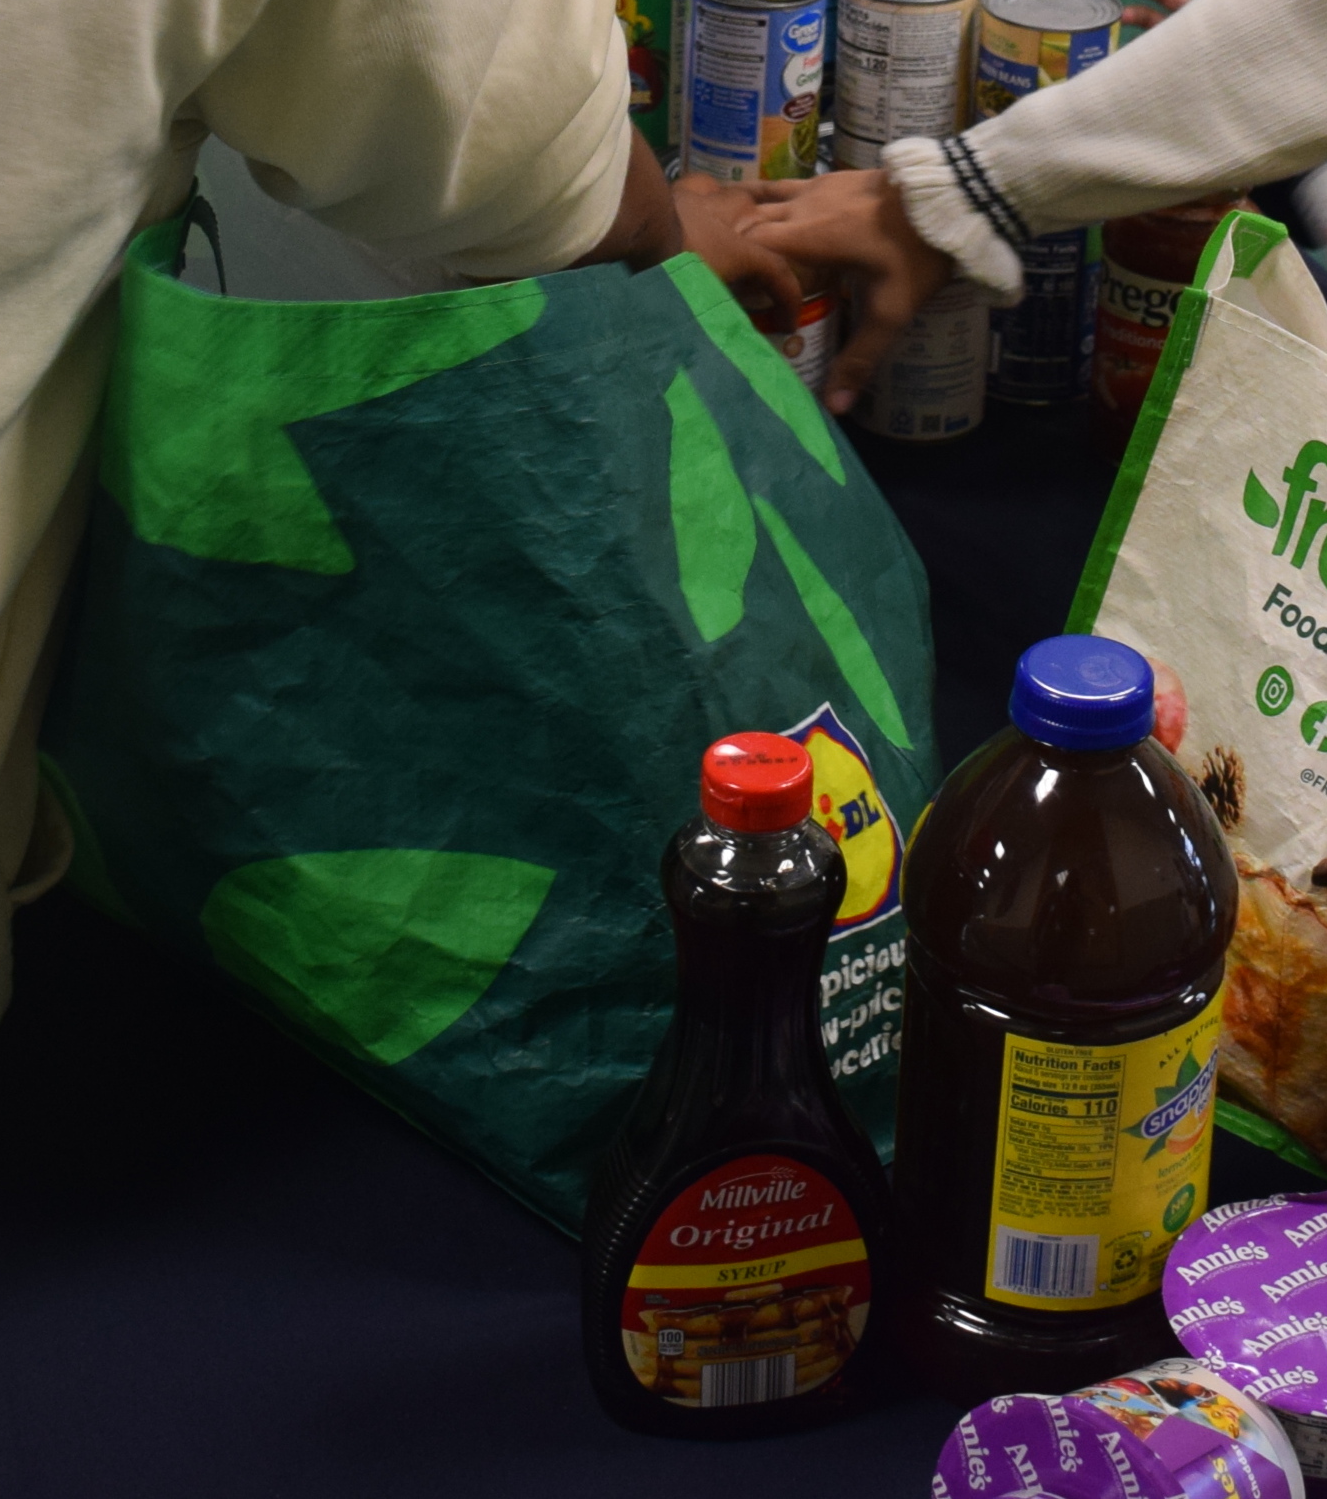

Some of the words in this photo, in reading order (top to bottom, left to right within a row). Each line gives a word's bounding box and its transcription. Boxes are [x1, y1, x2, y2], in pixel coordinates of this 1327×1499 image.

[819, 938, 907, 1009] piciou
[820, 981, 904, 1049] w-pric
[1015, 1050, 1078, 1071] Nutrition
[1082, 1059, 1122, 1071] Facts
[1158, 1047, 1182, 1069] ALL
[1013, 1073, 1041, 1088] Serving
[1042, 1079, 1057, 1089] size
[1061, 1082, 1070, 1090] 12
[1010, 1094, 1069, 1115] Calories
[1083, 1099, 1118, 1115] 110
[1009, 1117, 1027, 1128] Total
[1008, 1134, 1026, 1144] Total
[1026, 1139, 1076, 1151] Carbohydrate
[1005, 1160, 1032, 1172] Protein
[1157, 1150, 1193, 1178] lemon
[699, 1179, 808, 1212] Millville
[668, 1202, 836, 1251] Original
[717, 1260, 787, 1283] SYRUP
[1175, 1240, 1270, 1287] Annie's
[1169, 1295, 1247, 1336] nnie's
[659, 1331, 682, 1344] 100
[1241, 1364, 1320, 1401] nnie's
[957, 1411, 994, 1493] nnie's
